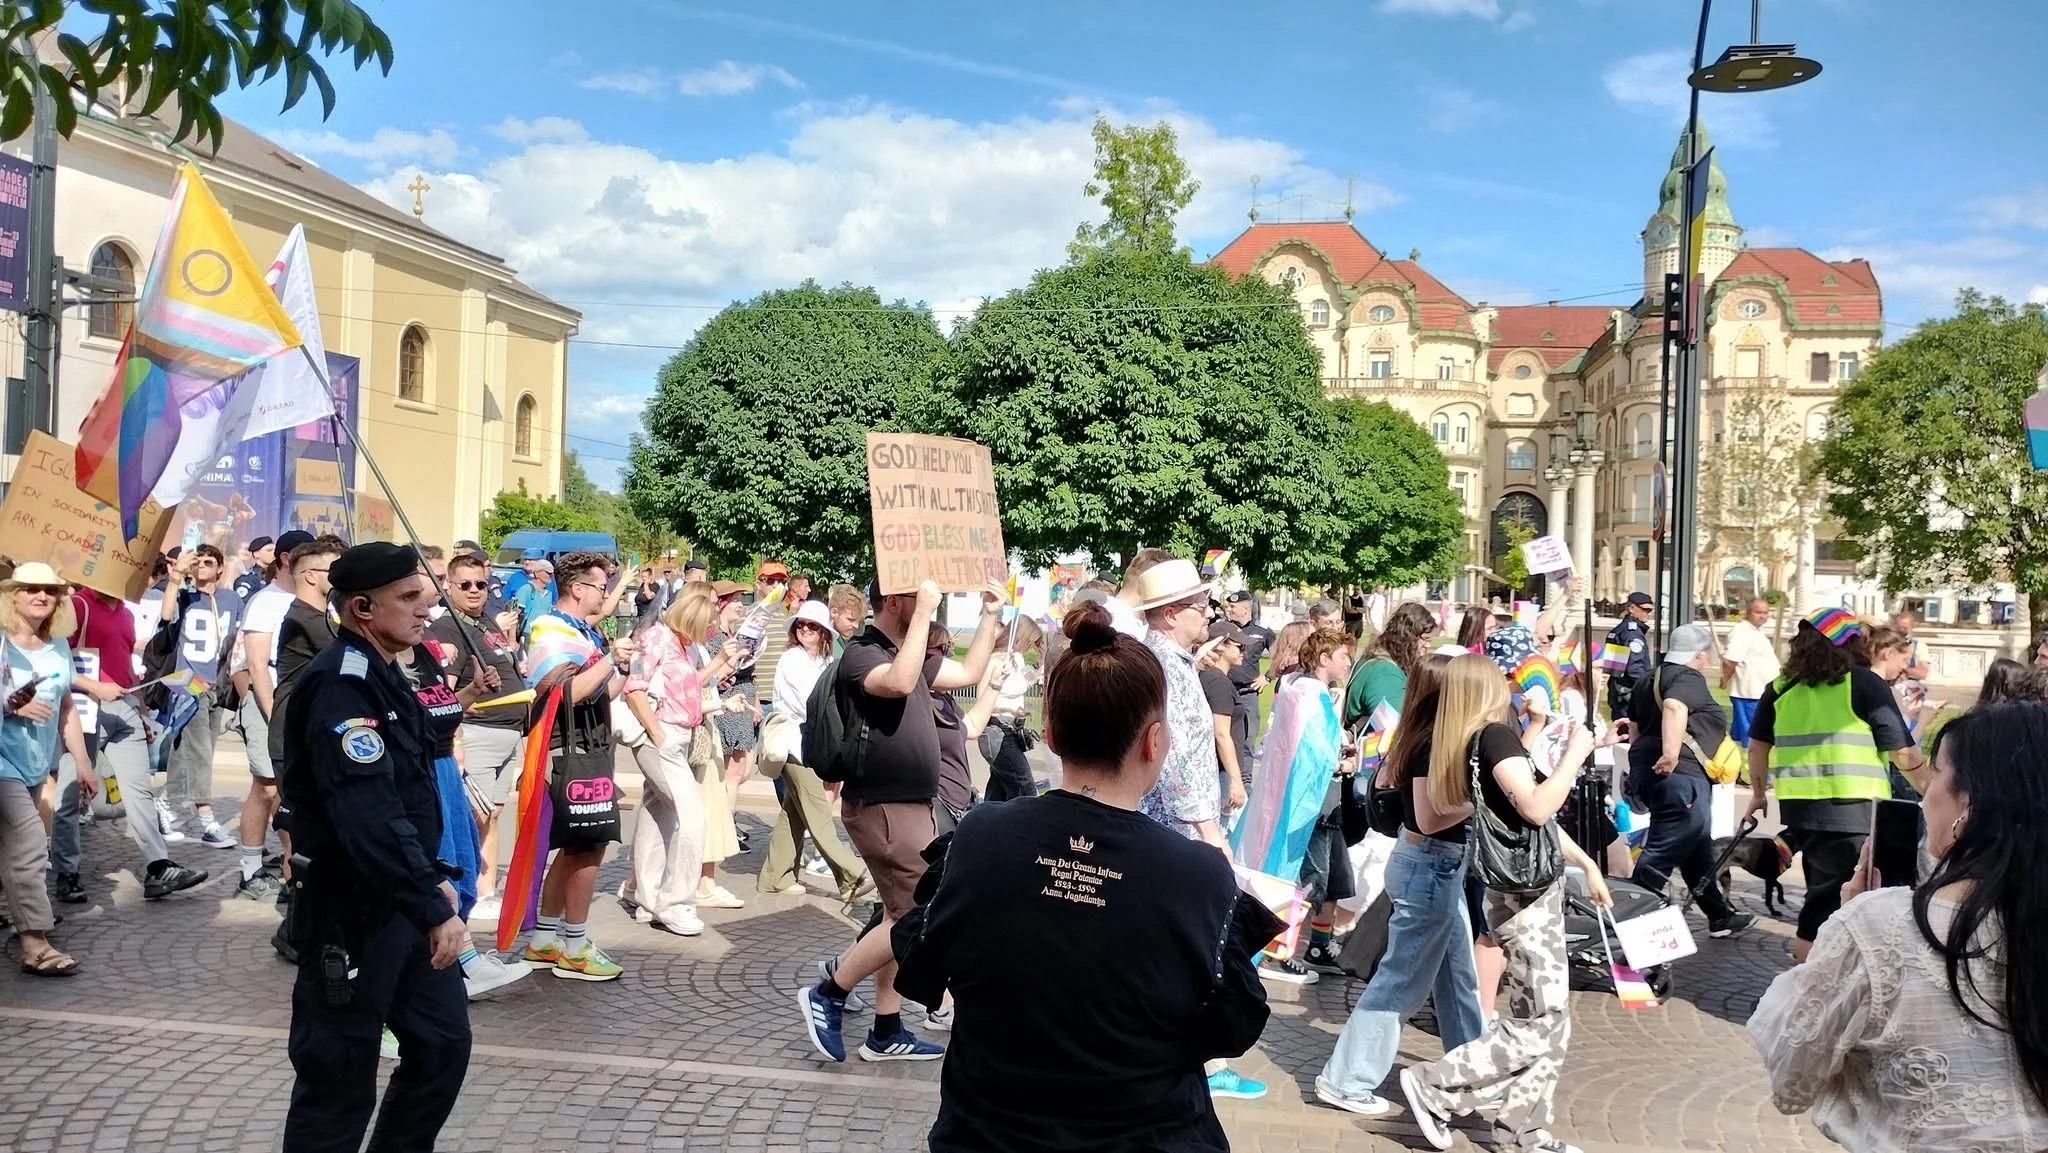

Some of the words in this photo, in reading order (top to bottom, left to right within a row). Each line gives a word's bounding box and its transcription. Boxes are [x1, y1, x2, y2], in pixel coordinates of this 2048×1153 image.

[871, 442, 918, 469] GOD
[922, 445, 951, 473] HELP
[951, 451, 973, 475] YOU
[21, 485, 42, 500] IN
[51, 497, 118, 530] SOLIDARITY
[875, 483, 927, 510] WITH
[930, 487, 957, 512] ALL
[954, 488, 983, 515] THIS
[12, 510, 36, 529] ARK
[40, 522, 53, 536] &
[880, 522, 921, 553] GOD
[922, 523, 966, 551] BLESS
[968, 526, 989, 553] ME
[887, 557, 921, 587] FOR
[927, 555, 954, 585] ALL
[950, 556, 984, 586] THIS
[182, 607, 231, 664] 91
[571, 781, 611, 800] PrEP
[568, 801, 614, 815] YOURSELF
[1035, 855, 1056, 866] Anna
[1056, 858, 1072, 869] Dei
[1050, 866, 1073, 880] Regni
[1041, 885, 1063, 898] Anna
